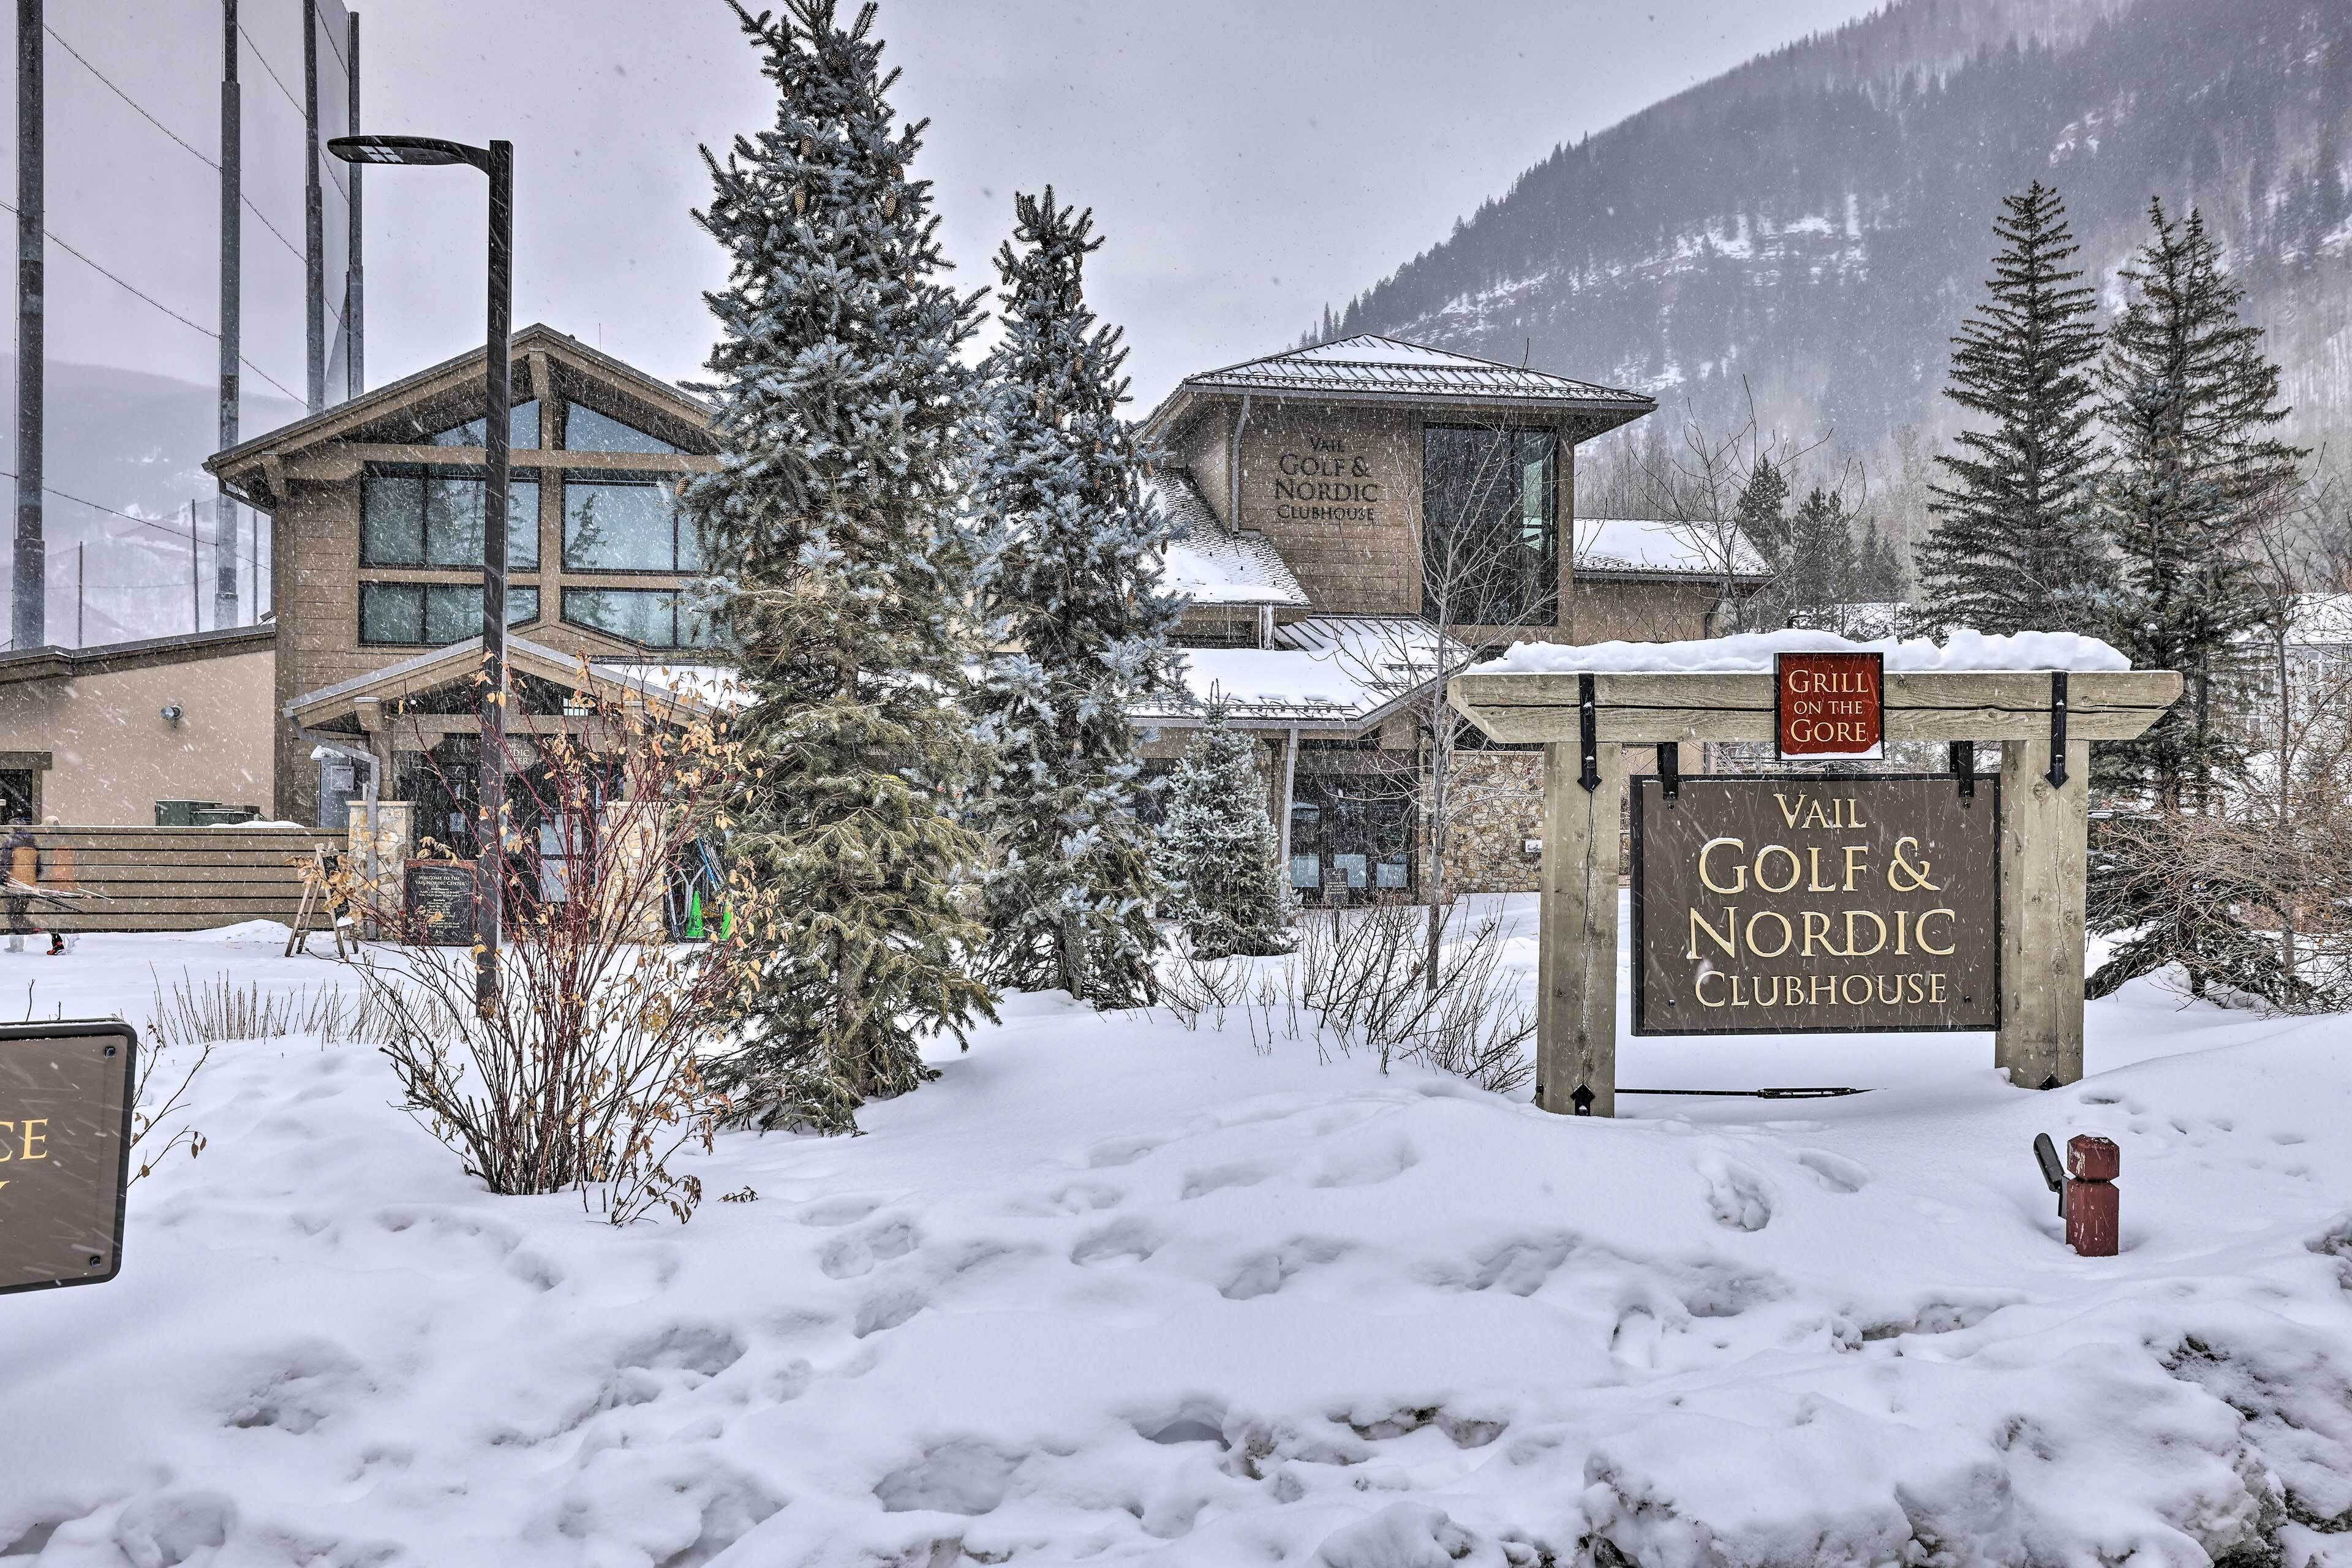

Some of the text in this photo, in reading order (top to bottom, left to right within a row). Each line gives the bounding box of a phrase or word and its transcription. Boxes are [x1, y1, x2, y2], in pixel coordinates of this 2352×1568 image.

[1311, 437, 1344, 452] VAIL
[1279, 453, 1371, 478] GOLF &
[1275, 478, 1378, 502] NORDIC
[1277, 504, 1374, 521] CLUBHOUSE
[1789, 669, 1869, 693] GRILL
[1793, 701, 1863, 715] ON THE
[1790, 718, 1867, 742] GORE
[1773, 793, 1867, 829] VAIL
[1698, 836, 1942, 894] GOLF &
[1686, 906, 1956, 960] NORDIC
[1695, 970, 1947, 1007] CLUBHOUSE
